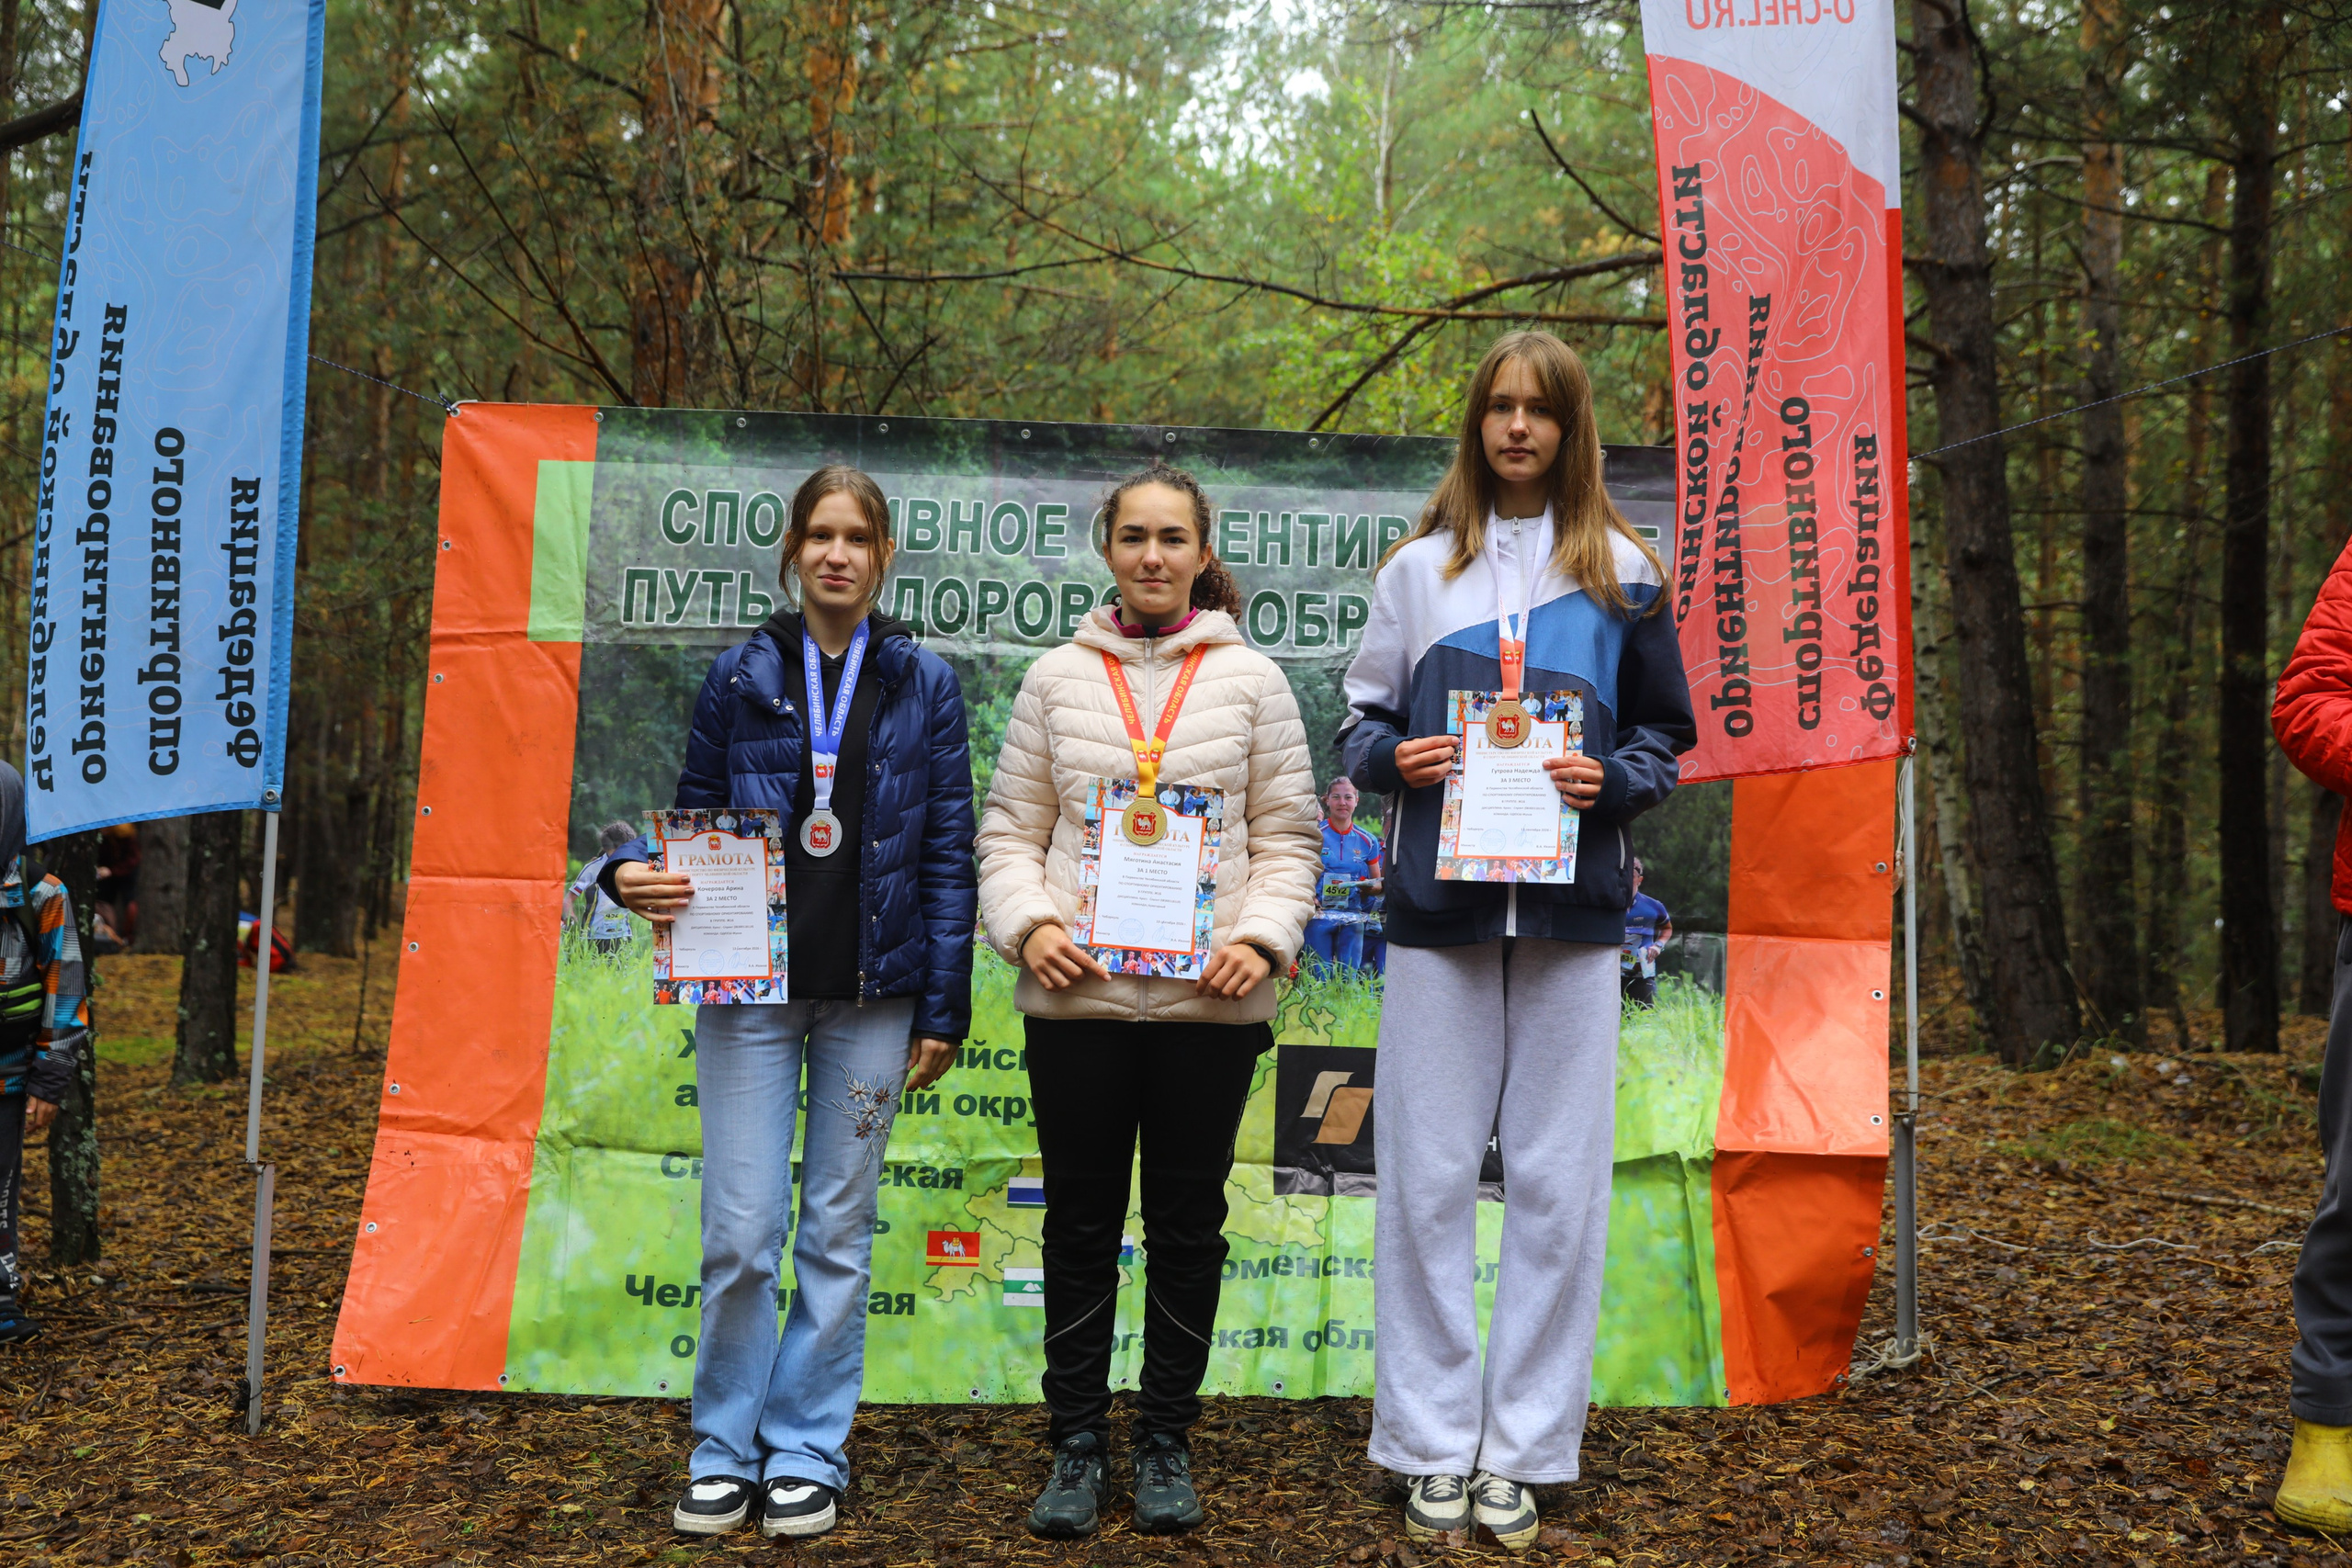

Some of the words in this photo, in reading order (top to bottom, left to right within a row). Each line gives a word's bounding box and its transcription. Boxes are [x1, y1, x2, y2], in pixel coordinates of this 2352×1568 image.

[623, 568, 775, 626] ПУТЬ
[842, 636, 865, 695] ЧЕЛЯБИНСКАЯ
[810, 671, 823, 737] ЧЕЛЯБИНСКАЯ
[832, 695, 848, 737] ОБЛАСТЬ
[1110, 666, 1136, 724] ЧЕЛЯБИНСКАЯ
[1164, 686, 1184, 724] ОБЛАСТЬ
[677, 853, 755, 866] ГРАМОТА
